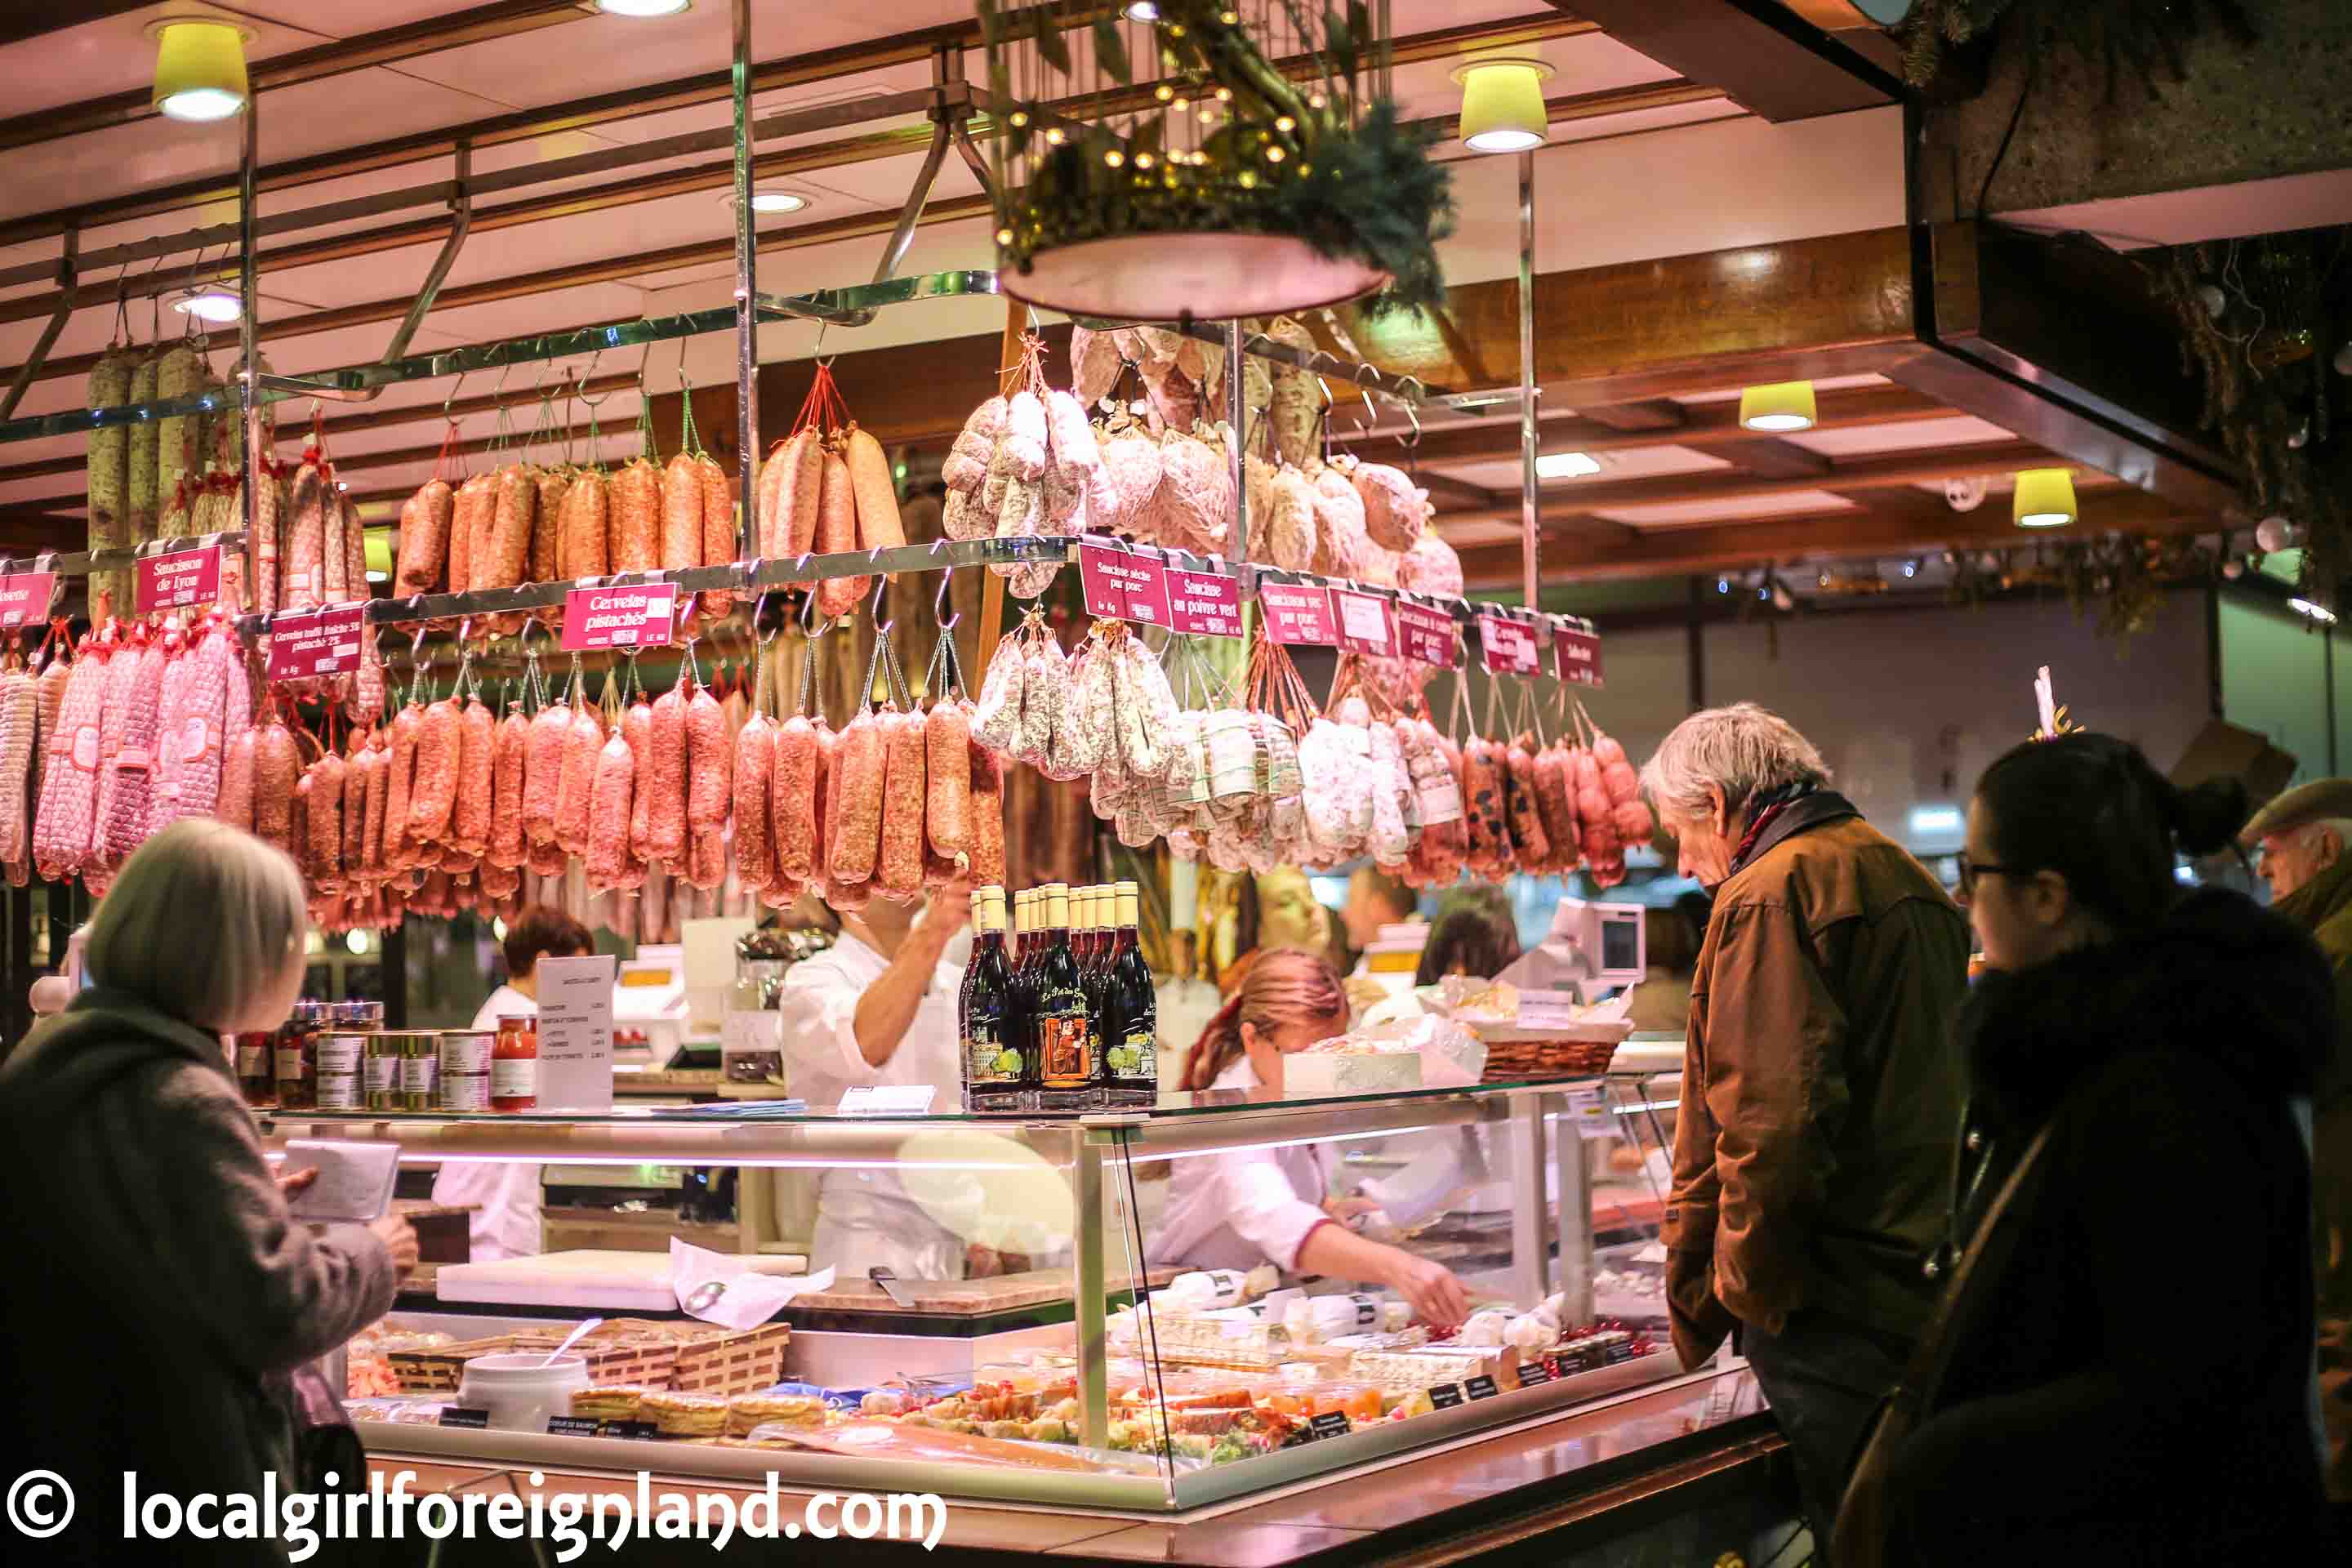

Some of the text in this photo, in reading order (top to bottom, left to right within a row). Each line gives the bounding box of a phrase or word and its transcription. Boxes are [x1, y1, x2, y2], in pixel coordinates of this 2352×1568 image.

[154, 559, 203, 576] Saucisson
[1097, 561, 1129, 577] Saucisse
[157, 575, 198, 591] de Lyon
[1125, 581, 1143, 593] porc
[1184, 579, 1222, 597] Saucisse
[590, 594, 647, 611] Cervelas
[1107, 603, 1117, 614] Kg
[1174, 599, 1237, 617] au poivre vert
[584, 612, 647, 632] pistachés
